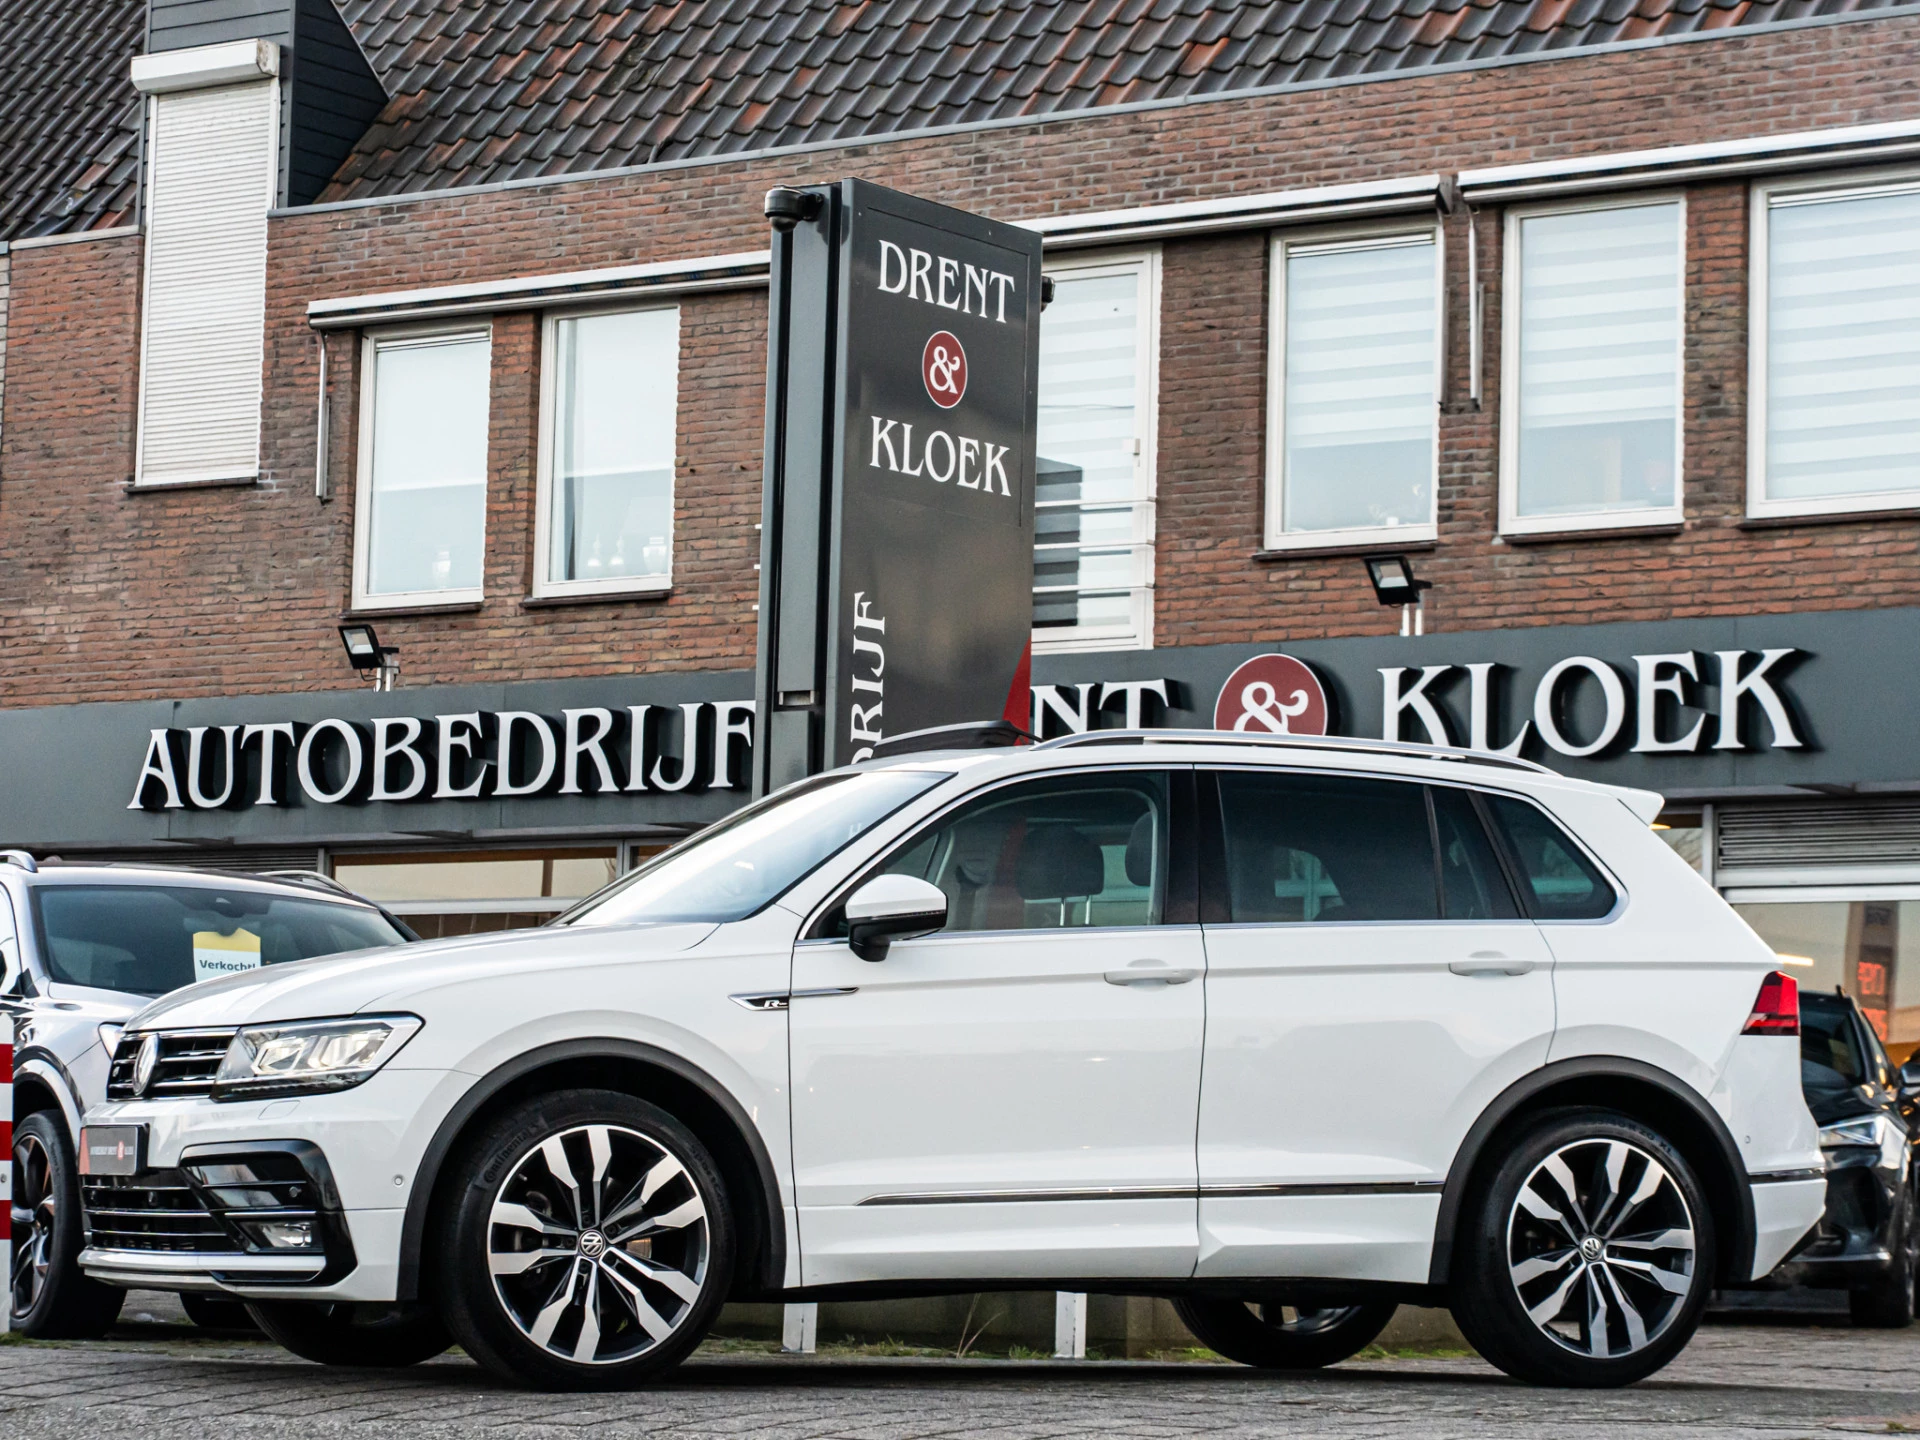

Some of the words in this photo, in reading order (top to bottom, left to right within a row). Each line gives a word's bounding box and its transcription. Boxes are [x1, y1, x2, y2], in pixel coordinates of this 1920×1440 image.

[878, 239, 1015, 324] DRENT
[930, 346, 961, 395] &
[869, 415, 1012, 497] KLOEK
[126, 699, 757, 809] AUTOBEDRIJF
[1031, 678, 1170, 742] NT
[1377, 648, 1803, 758] KLOEK
